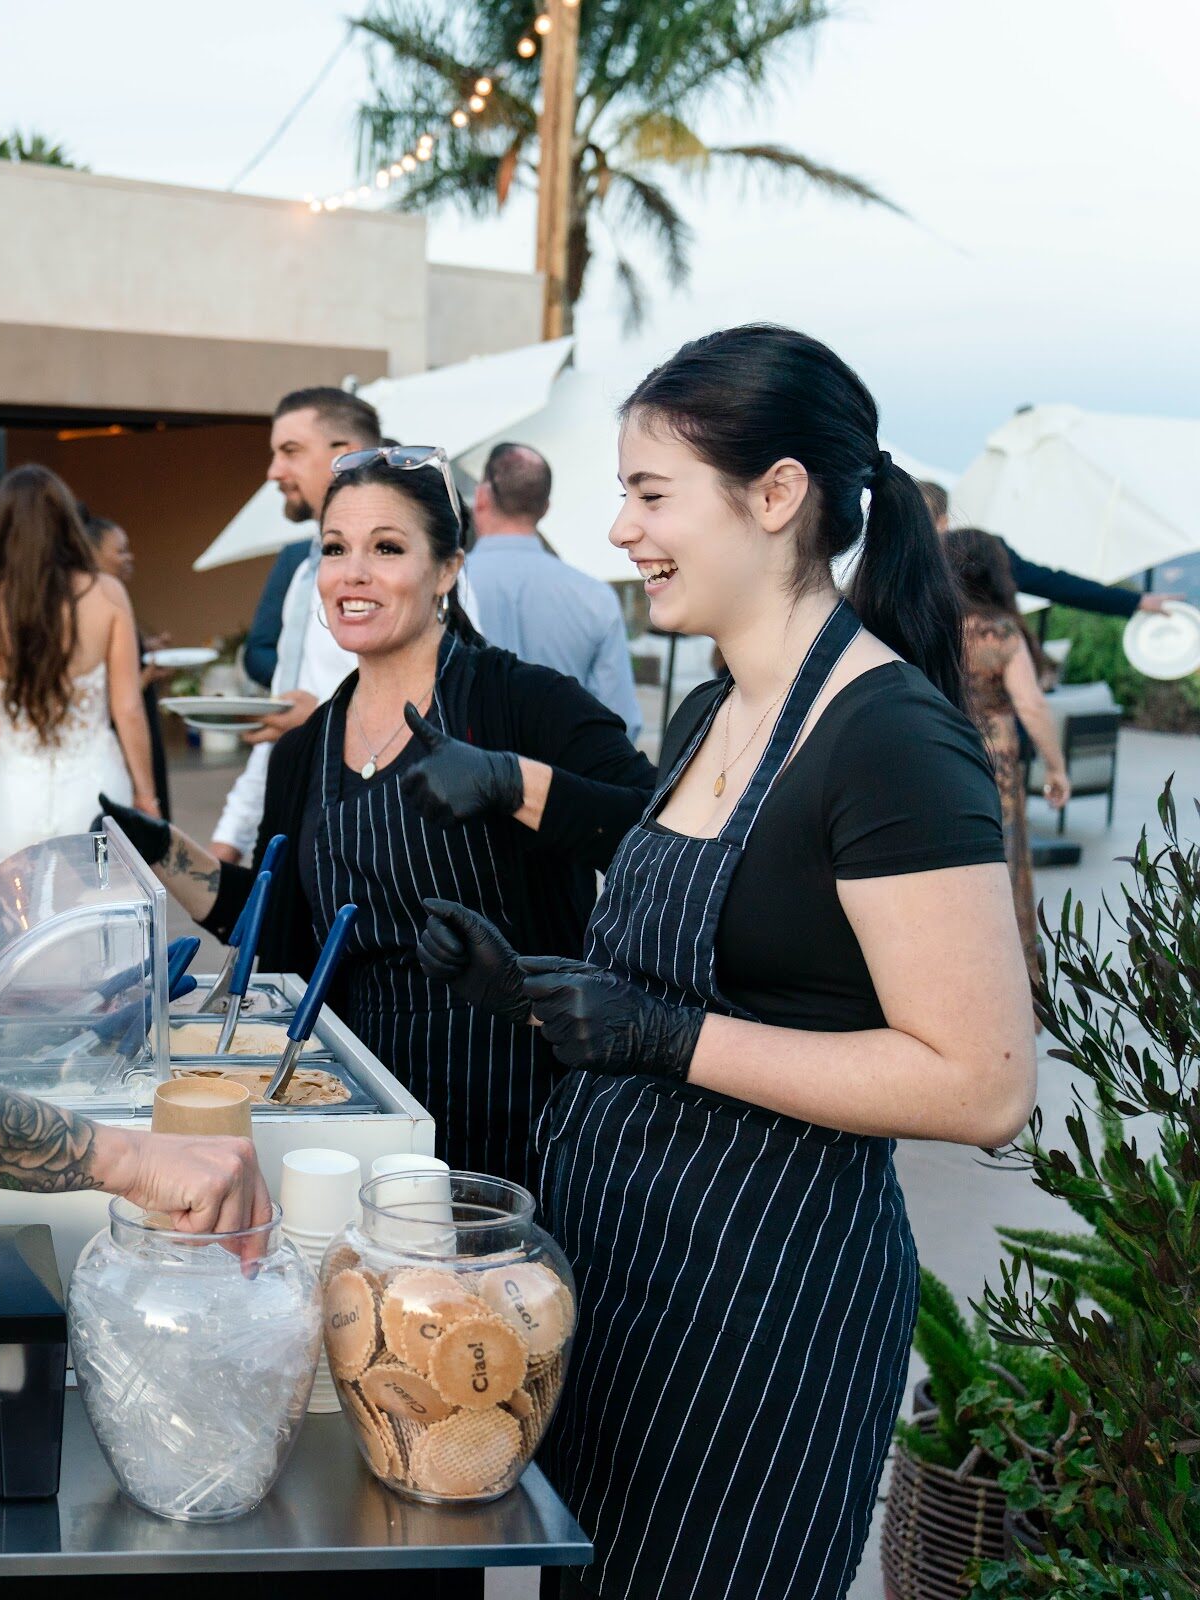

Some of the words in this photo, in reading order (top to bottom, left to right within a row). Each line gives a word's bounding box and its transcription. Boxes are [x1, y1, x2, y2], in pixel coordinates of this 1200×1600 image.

[331, 1305, 360, 1330] Ciao!
[504, 1280, 540, 1331] Ciao!
[467, 1341, 490, 1394] Ciao!
[385, 1381, 427, 1415] Ciao!
